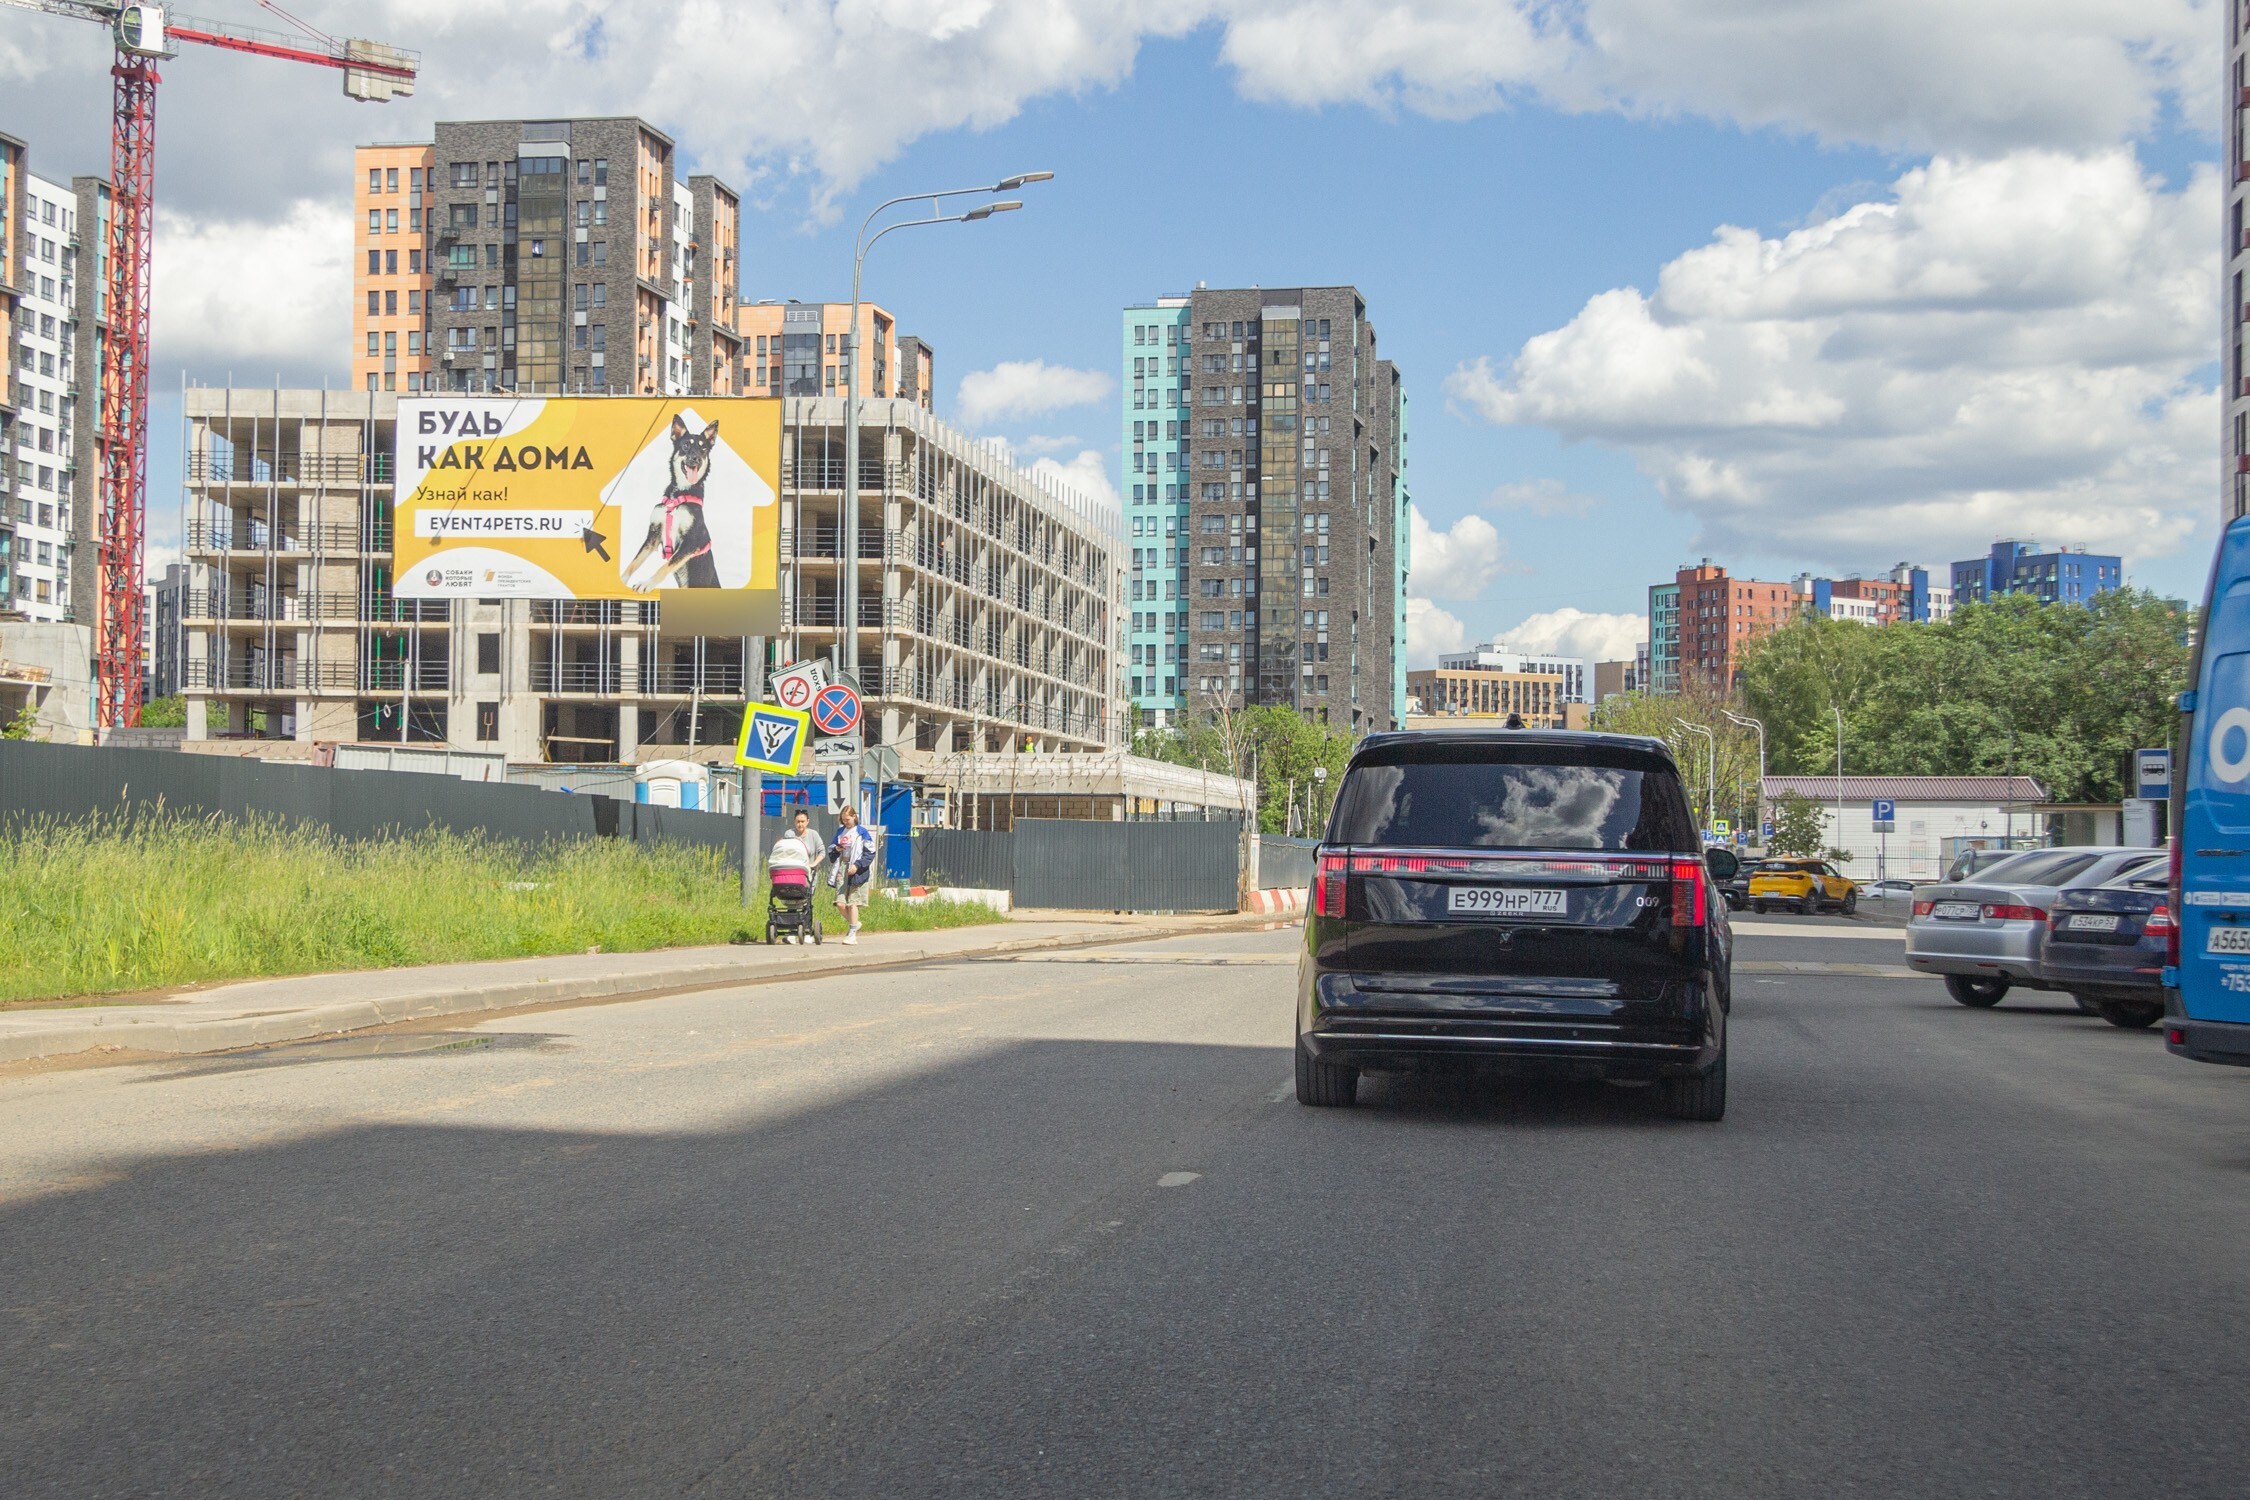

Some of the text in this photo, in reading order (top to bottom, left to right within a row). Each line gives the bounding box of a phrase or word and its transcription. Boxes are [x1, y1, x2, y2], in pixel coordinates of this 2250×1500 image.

[418, 410, 503, 437] БУДЬ
[417, 445, 594, 472] КАК ДОМА
[416, 486, 508, 501] Узнай как!
[430, 517, 563, 531] EVENT4PETS.RU
[1471, 862, 1543, 872] ZEEKR
[1533, 890, 1562, 906] 777
[1636, 896, 1660, 907] 009
